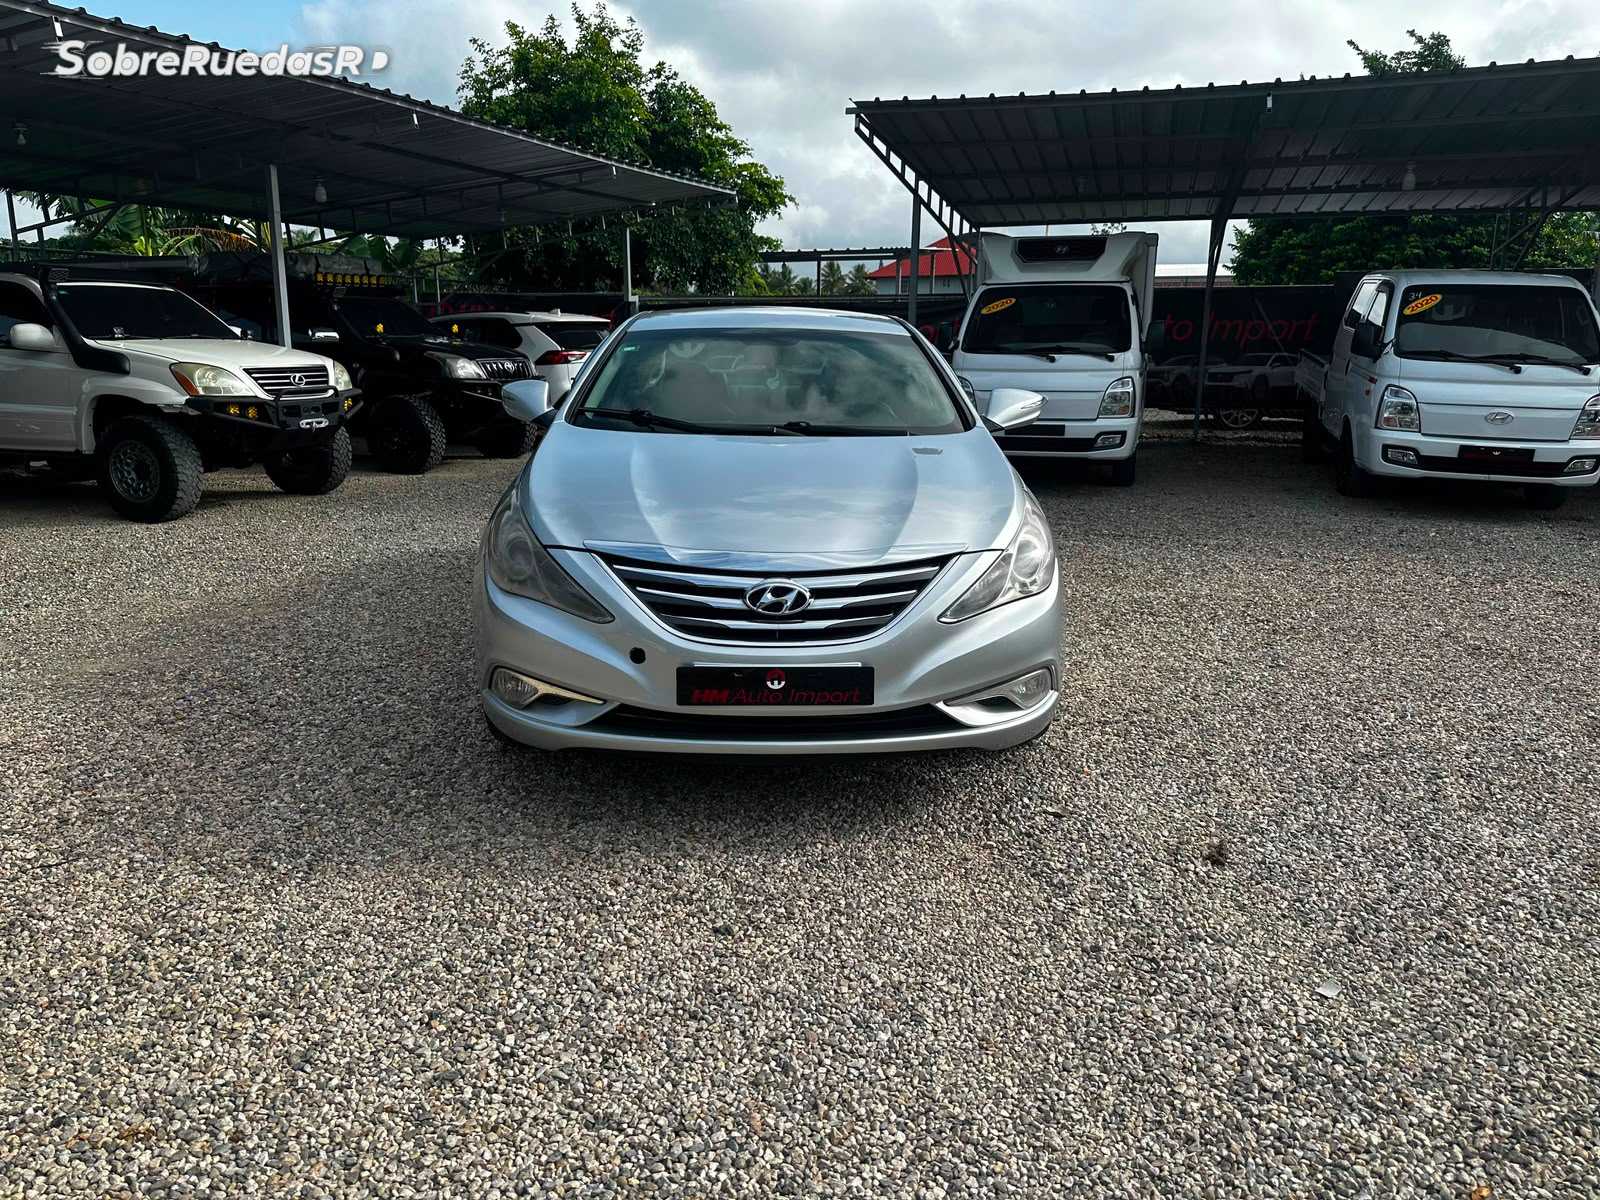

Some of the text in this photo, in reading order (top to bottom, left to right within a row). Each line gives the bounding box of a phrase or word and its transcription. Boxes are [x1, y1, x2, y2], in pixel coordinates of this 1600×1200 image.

[984, 299, 1013, 312] 2020
[1407, 295, 1438, 312] 2020
[1164, 312, 1196, 342] to
[731, 688, 783, 704] Auto
[787, 688, 861, 705] Import
